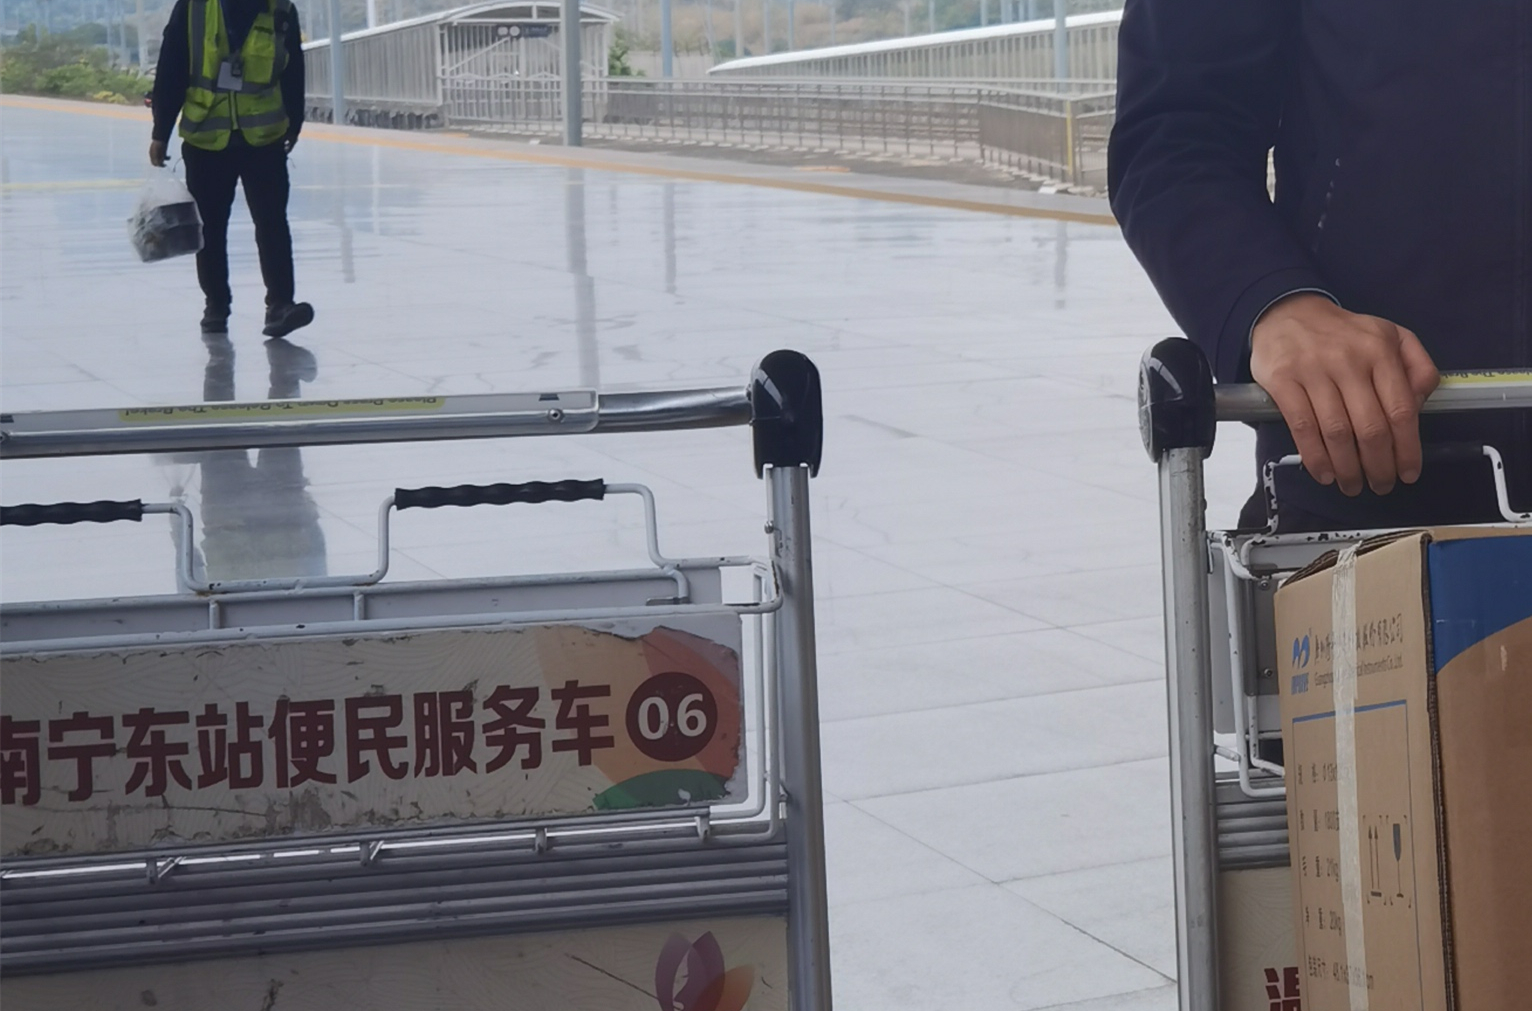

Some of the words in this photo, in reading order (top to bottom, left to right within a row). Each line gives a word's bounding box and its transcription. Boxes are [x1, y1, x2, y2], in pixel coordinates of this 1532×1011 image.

[0, 680, 615, 806] 南宁东站便民服务车
[637, 692, 709, 742] 06
